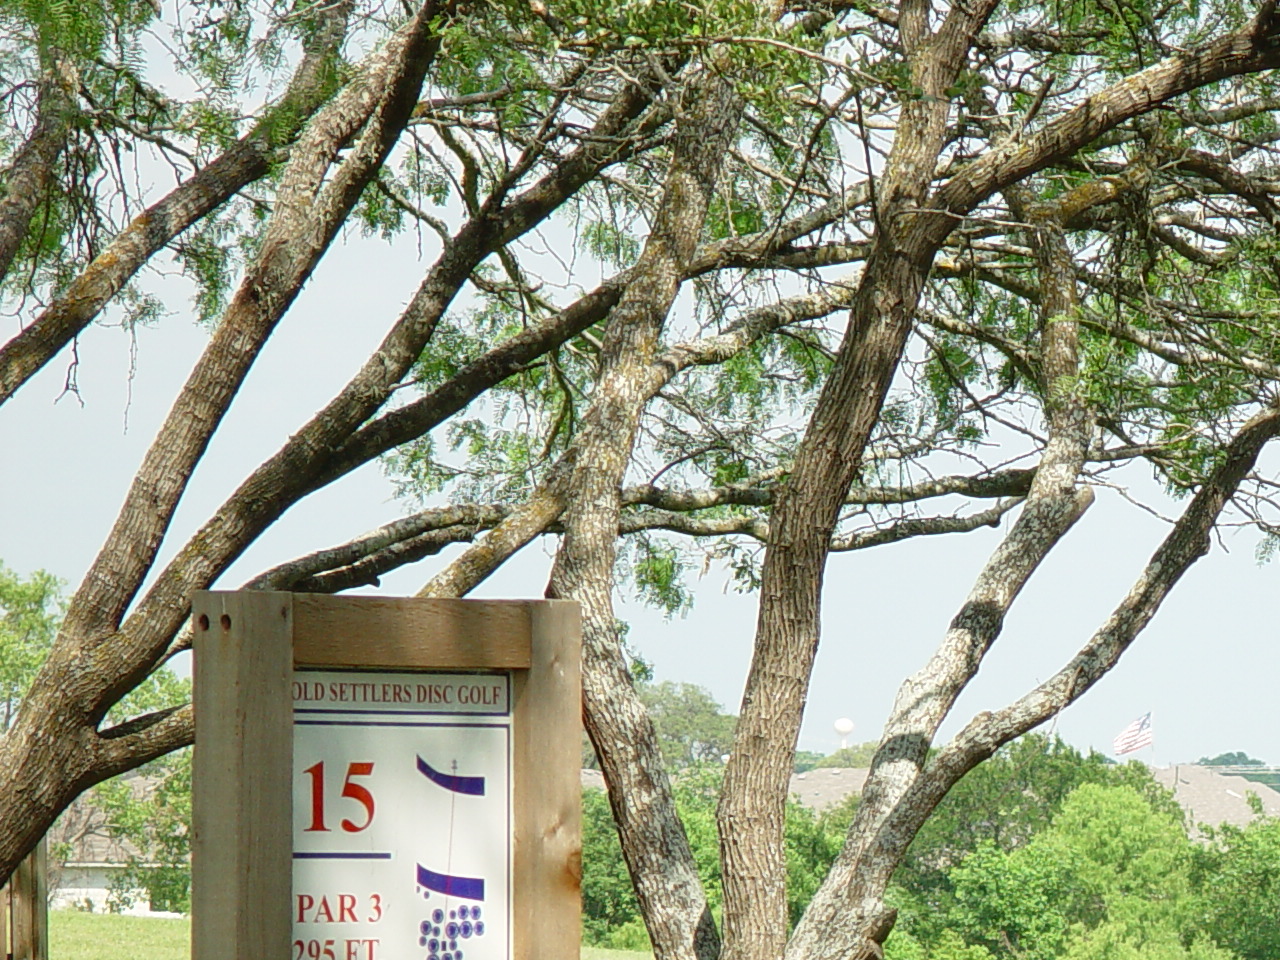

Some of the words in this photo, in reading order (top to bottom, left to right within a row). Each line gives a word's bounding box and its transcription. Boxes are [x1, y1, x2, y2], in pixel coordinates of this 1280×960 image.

[292, 682, 325, 701] OLD
[329, 682, 412, 703] SETTLERS
[416, 684, 453, 704] DISC
[458, 685, 501, 705] GOLF
[303, 760, 375, 833] 15
[296, 894, 359, 923] PAR
[368, 894, 382, 923] 3
